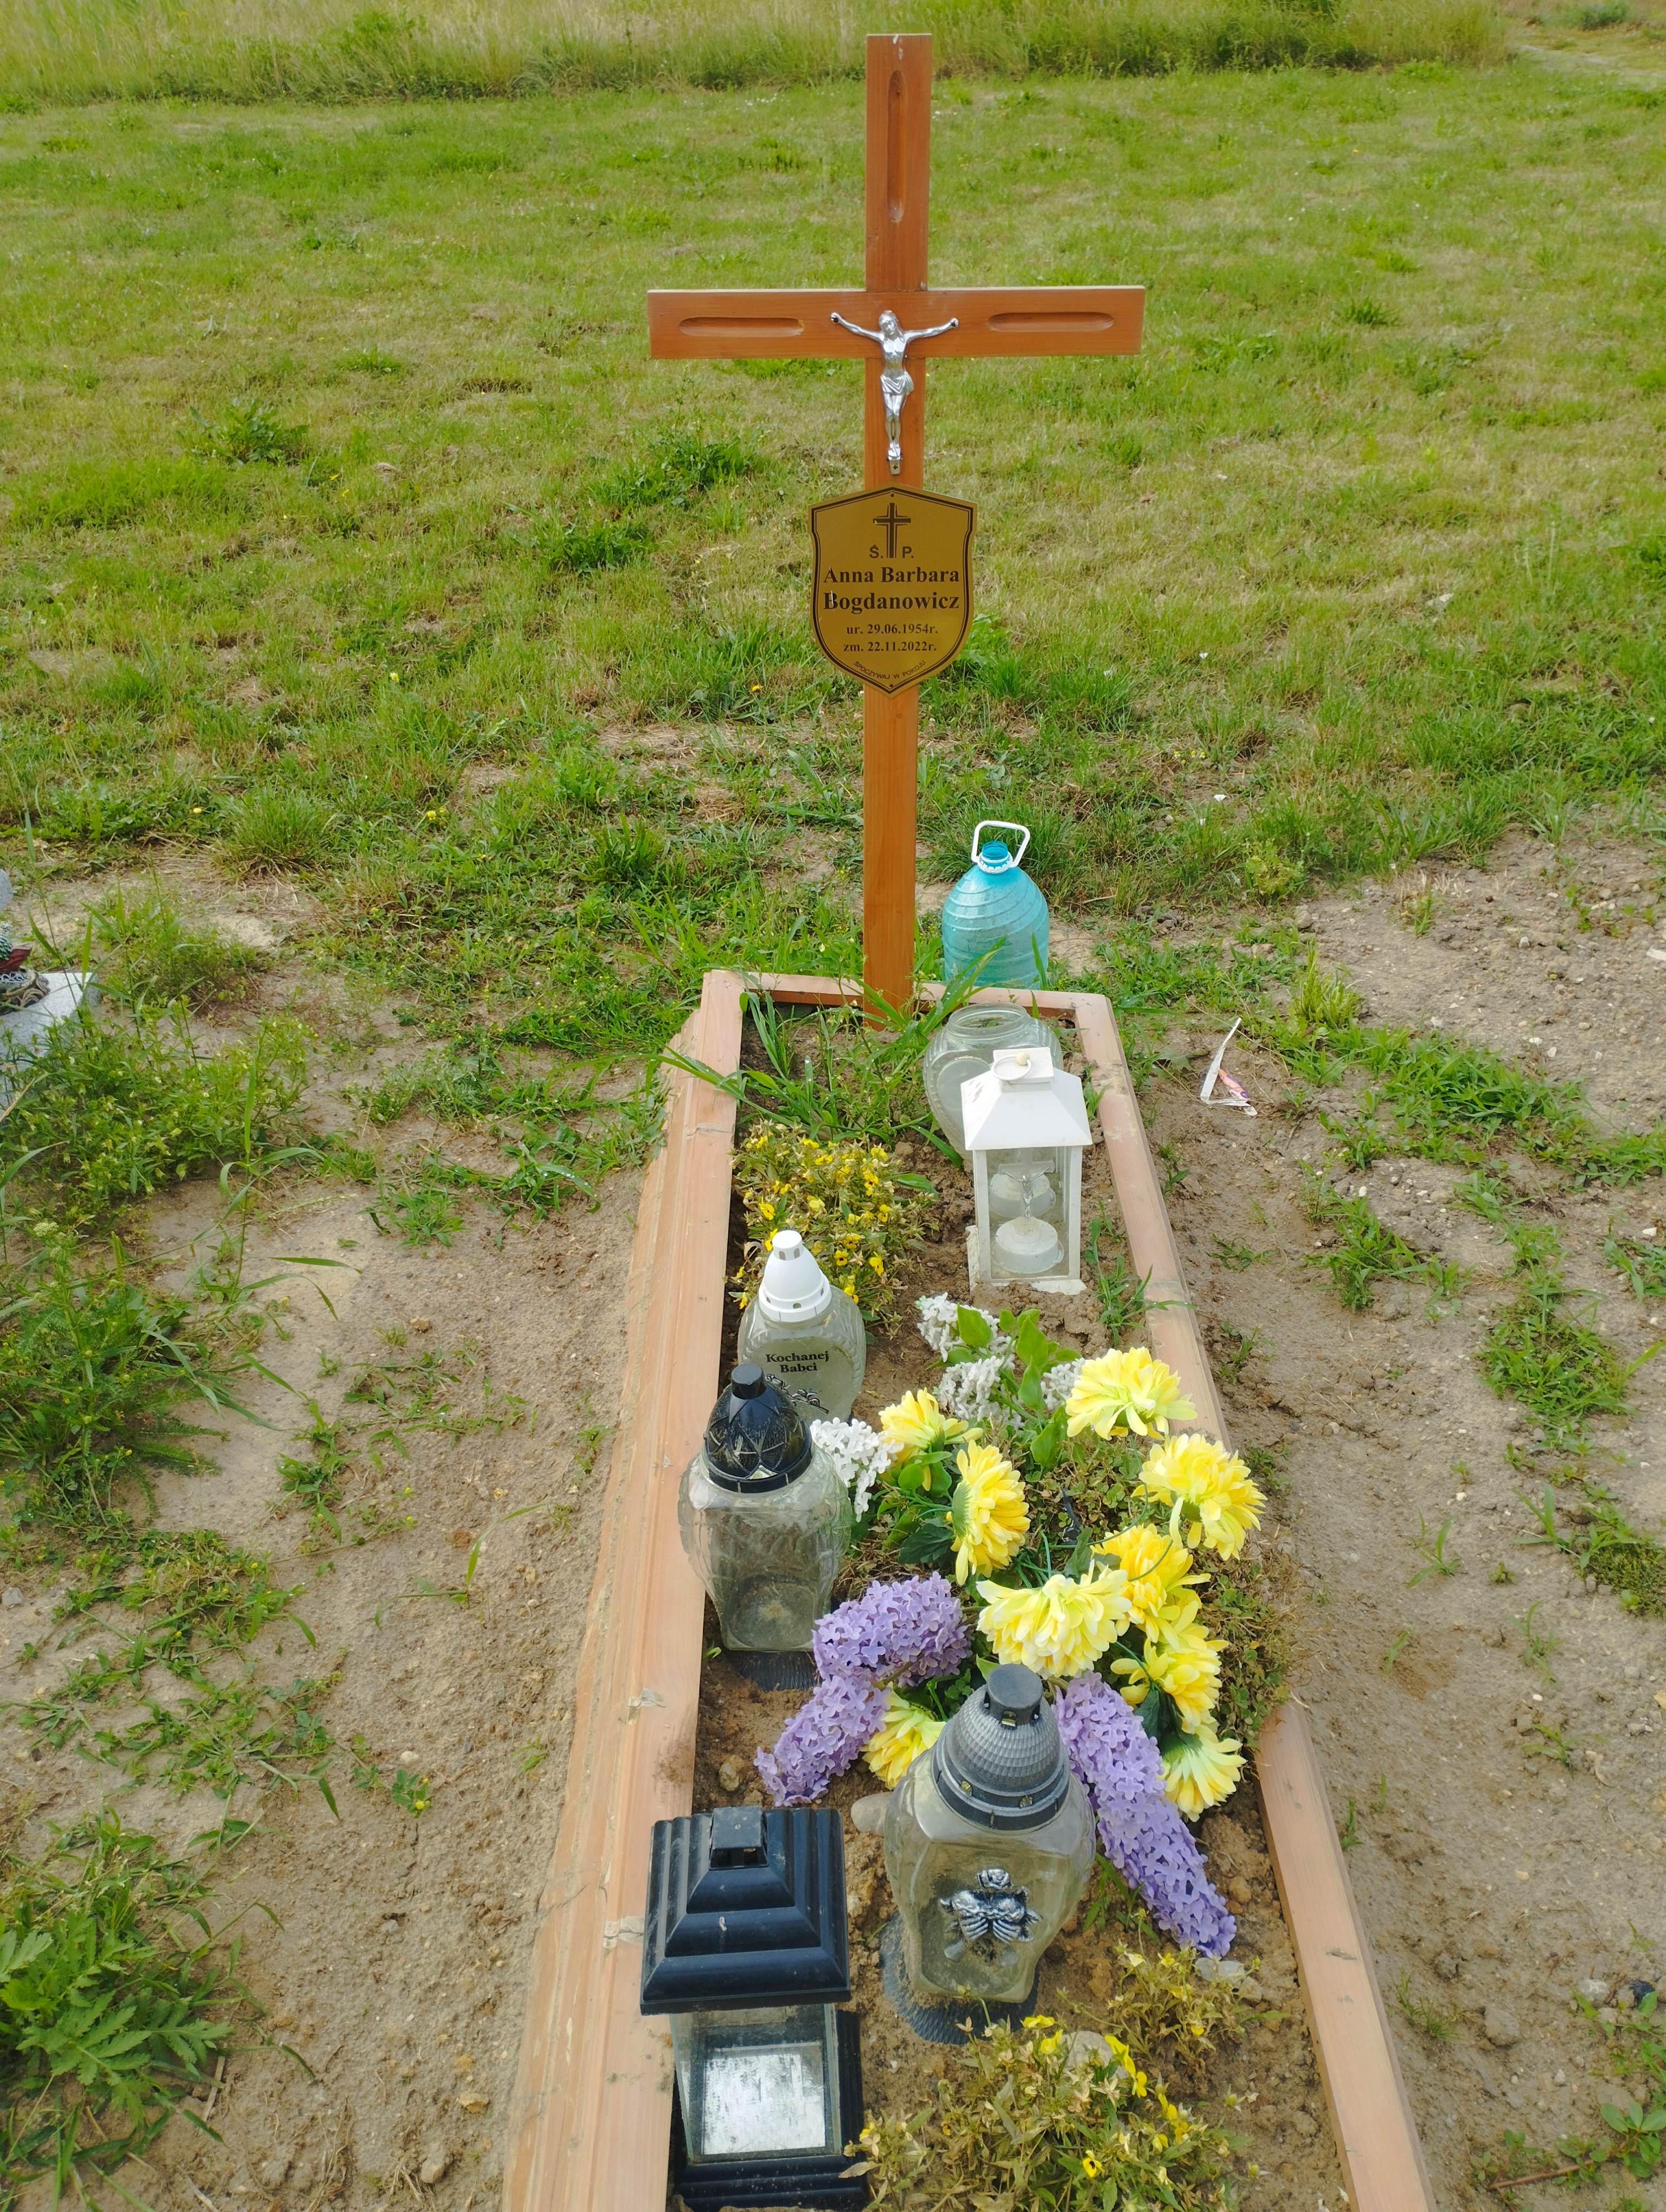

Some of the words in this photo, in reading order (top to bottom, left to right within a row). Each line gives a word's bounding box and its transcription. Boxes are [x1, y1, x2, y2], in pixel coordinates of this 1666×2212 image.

[869, 544, 883, 559] Ś.
[902, 546, 914, 559] P.
[824, 567, 874, 583] Anna
[881, 567, 959, 583] Barbara
[823, 591, 959, 614] Bogdanowicz
[847, 626, 863, 634] ur.
[868, 623, 938, 634] 29.06.1954r.
[843, 644, 864, 652] zm.
[868, 641, 937, 652] 22.11.2022r.
[853, 661, 890, 680] SPOCZYWAJ
[902, 660, 926, 677] POKOJU
[765, 1351, 830, 1362] Kochanej
[780, 1362, 818, 1373] Babci
